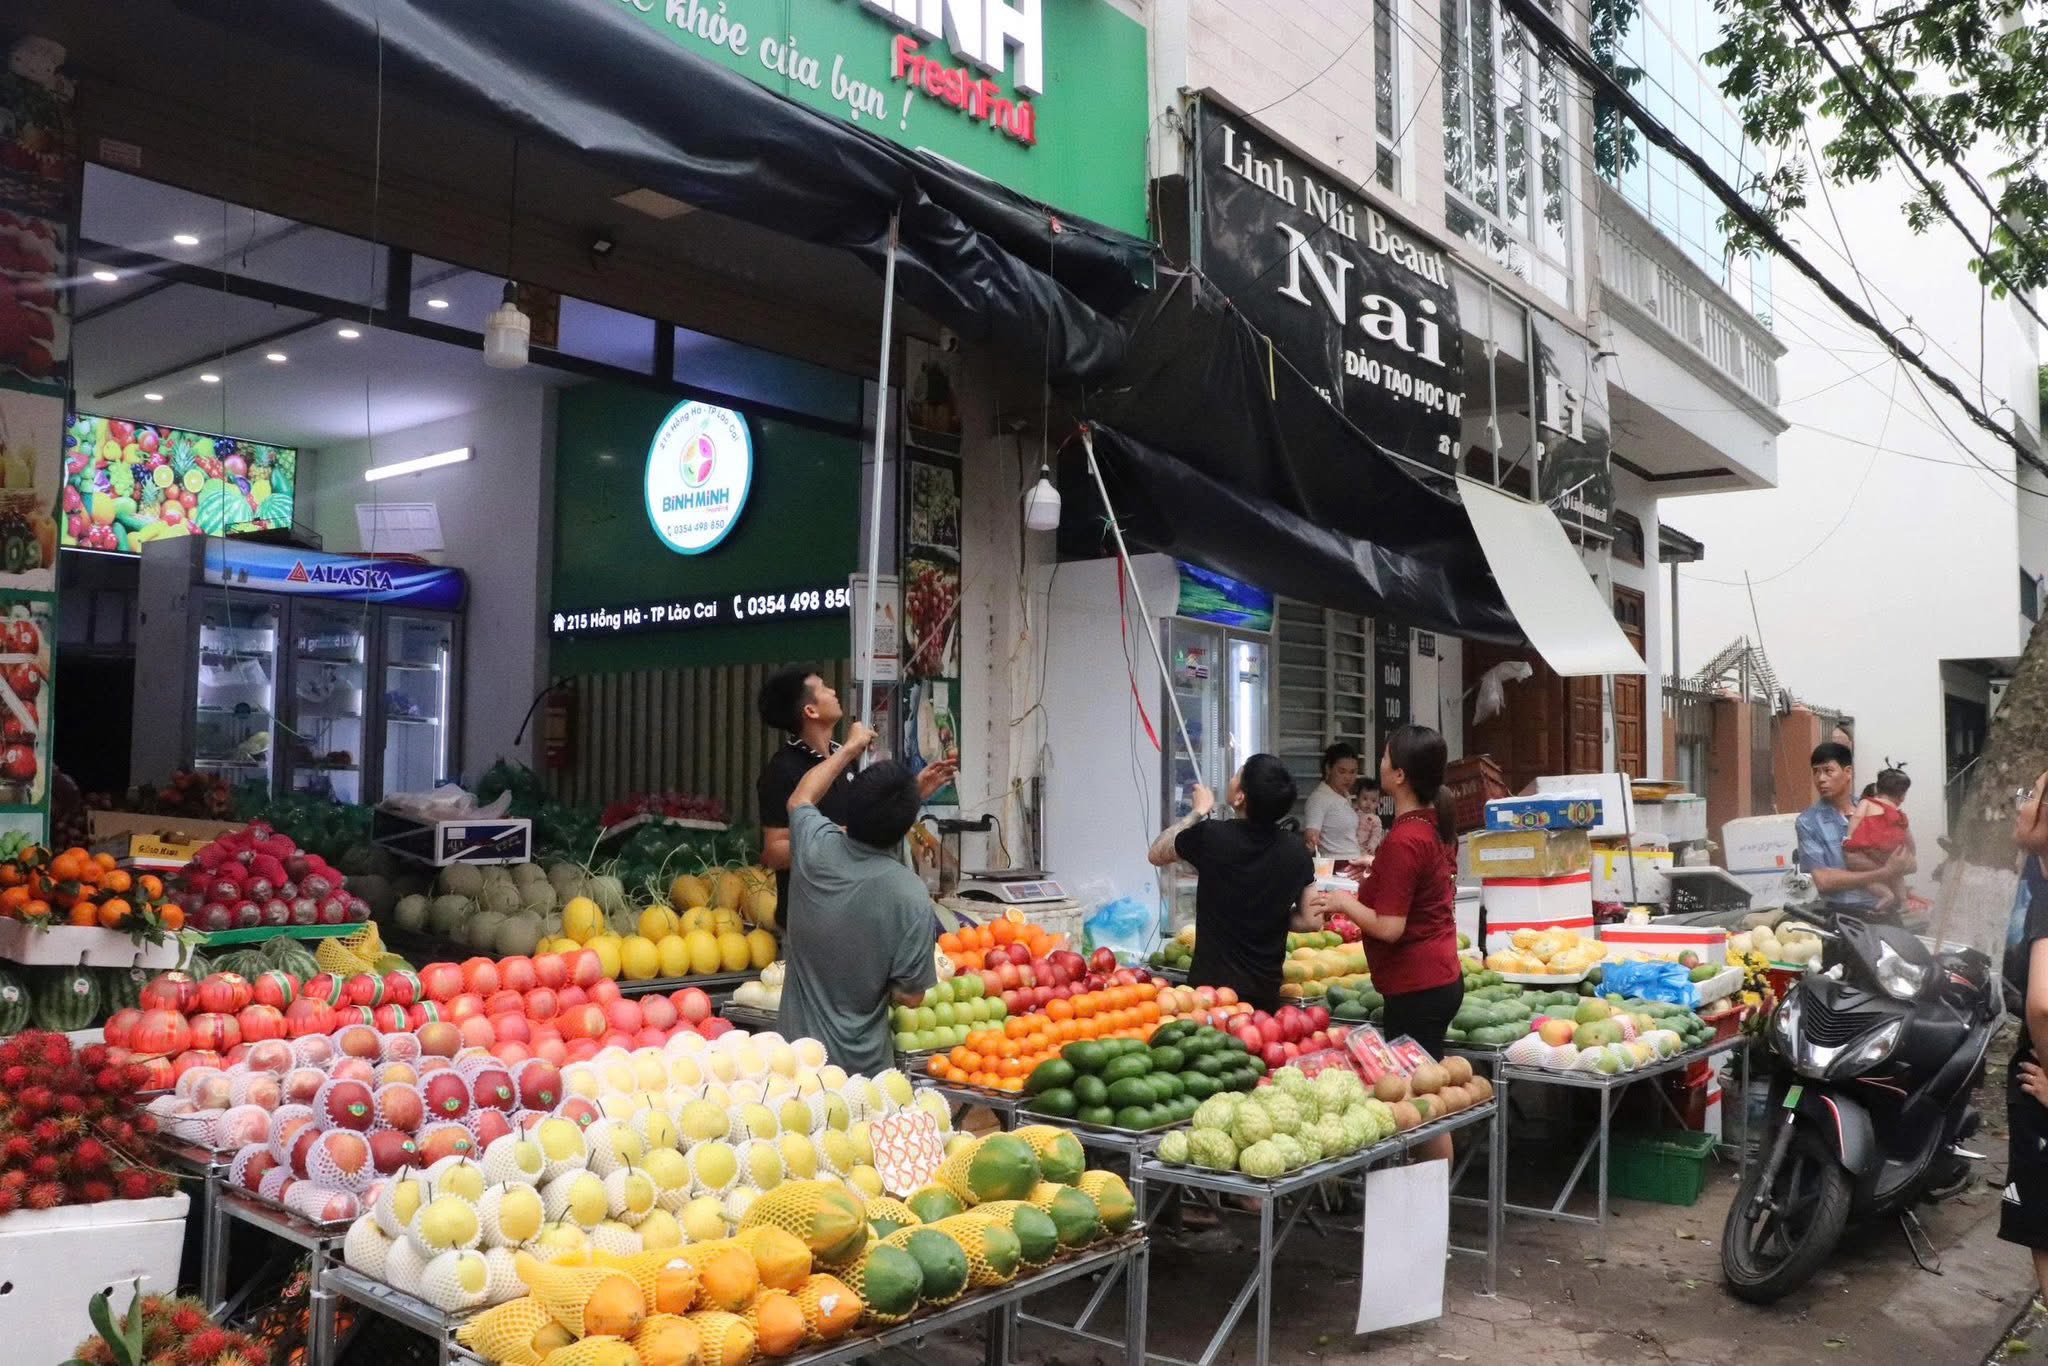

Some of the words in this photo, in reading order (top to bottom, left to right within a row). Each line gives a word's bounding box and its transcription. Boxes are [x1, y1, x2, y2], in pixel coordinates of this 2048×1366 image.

[760, 35, 821, 89] của
[831, 54, 888, 120] bạn
[1221, 124, 1297, 207] Linh
[1303, 176, 1357, 242] Nhi
[1363, 205, 1449, 290] Beaut
[1276, 221, 1446, 367] Nai
[1345, 348, 1381, 386] ĐÀO
[1382, 364, 1412, 401] TẠO
[1414, 378, 1444, 414] HỌC
[673, 524, 692, 535] 0354
[694, 522, 708, 532] 498
[310, 564, 393, 591] ALASKA
[567, 614, 588, 630] 215
[590, 608, 621, 630] Hồng
[623, 607, 641, 625] Hà
[650, 606, 666, 623] TP
[667, 603, 691, 621] Lào
[693, 601, 717, 619] Cai
[747, 594, 786, 616] 0354
[790, 591, 820, 611] 498
